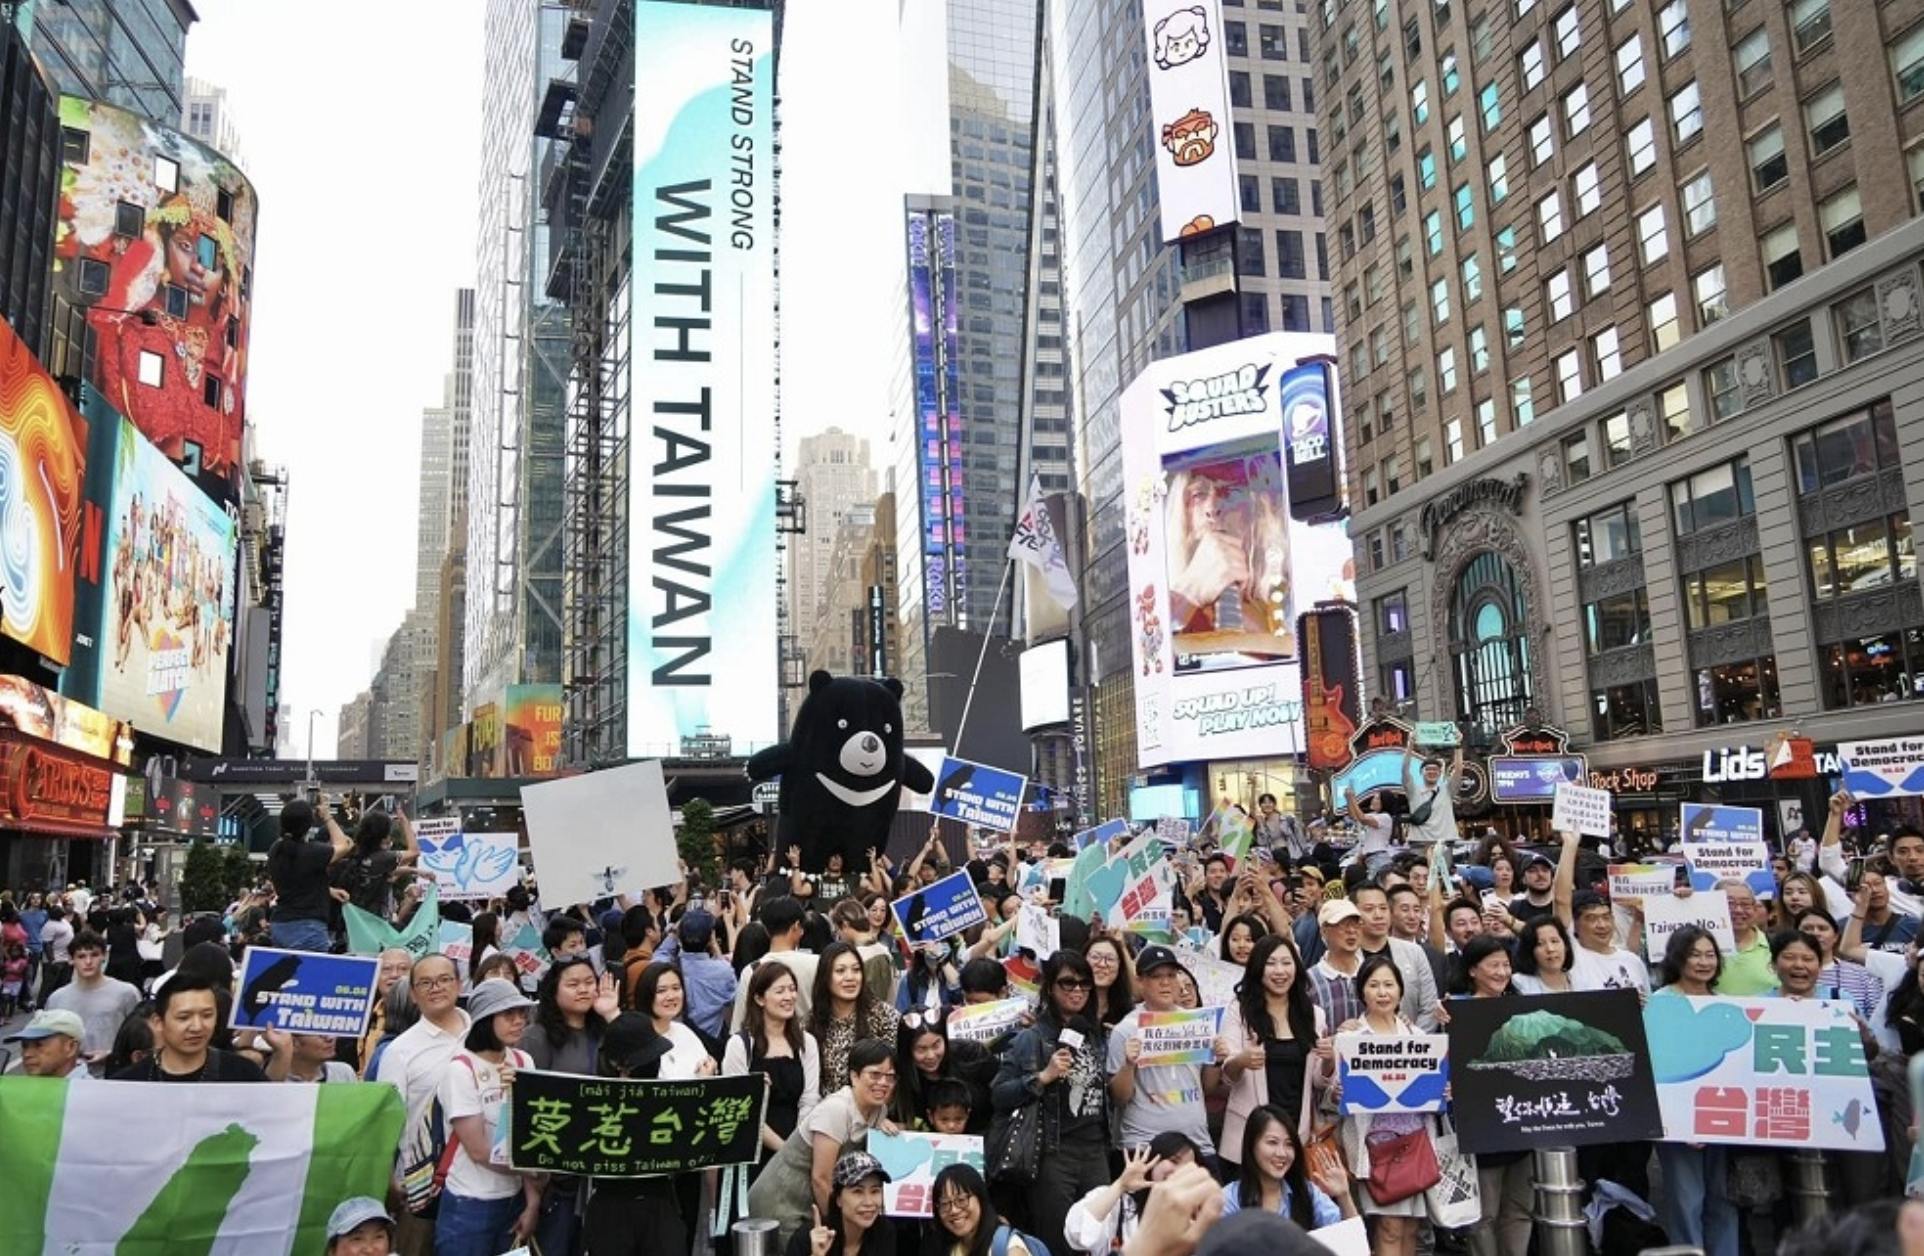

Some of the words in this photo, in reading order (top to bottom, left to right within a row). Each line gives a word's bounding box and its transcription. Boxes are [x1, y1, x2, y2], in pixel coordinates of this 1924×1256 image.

[731, 38, 753, 126] STAND
[731, 134, 753, 251] STRONG
[654, 179, 712, 362] WITH
[1170, 364, 1258, 404] SQUAD
[1291, 435, 1324, 450] TACO
[1293, 446, 1326, 465] BELL
[1421, 472, 1527, 561] Paramount
[652, 386, 711, 686] TAIWAN
[535, 705, 562, 722] FUR
[1173, 693, 1238, 719] SQUAD
[1242, 683, 1277, 708] UP!
[1073, 697, 1086, 752] SQUARE
[1199, 709, 1249, 736] PLAY
[1250, 701, 1300, 728] NOW
[1850, 753, 1924, 767] Democrac
[1855, 743, 1897, 756] Stand
[1901, 741, 1924, 752] for
[1703, 746, 1765, 782] Lids
[1813, 753, 1841, 773] TA
[1589, 771, 1621, 792] Rock
[1622, 768, 1657, 791] Shop
[944, 787, 984, 805] STAND
[985, 797, 1015, 814] WITH
[1693, 828, 1728, 837] STAND
[1730, 831, 1759, 840] WITH
[1694, 858, 1763, 868] Democracy
[1698, 847, 1733, 857] Stand
[1735, 847, 1754, 856] for
[912, 910, 948, 932] STAND
[949, 897, 977, 916] WITH
[255, 991, 317, 1008] STAND
[320, 997, 366, 1012] WITH
[1358, 1042, 1402, 1055] Stand
[1407, 1040, 1431, 1054] for
[1753, 1024, 1869, 1077] 民主
[1351, 1057, 1438, 1070] Democracy
[1694, 1087, 1811, 1140] 台灣
[538, 1153, 554, 1165] Do
[562, 1159, 585, 1171] not
[593, 1161, 626, 1173] piss
